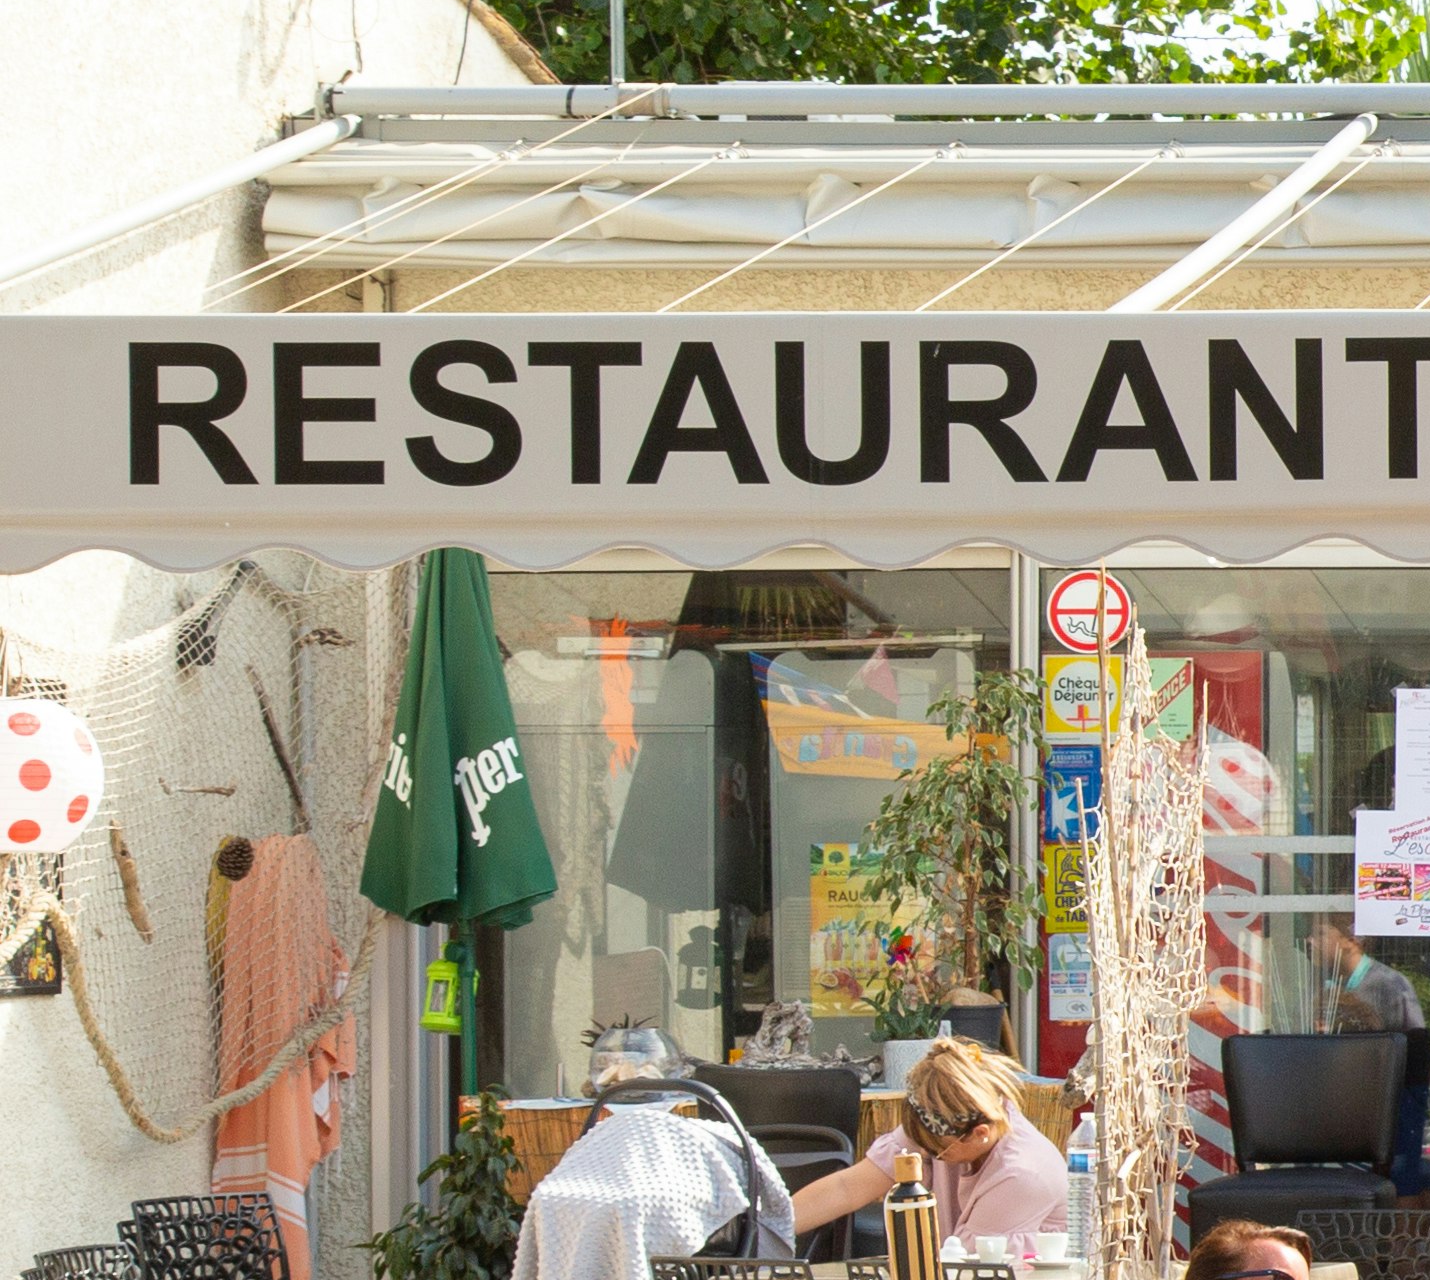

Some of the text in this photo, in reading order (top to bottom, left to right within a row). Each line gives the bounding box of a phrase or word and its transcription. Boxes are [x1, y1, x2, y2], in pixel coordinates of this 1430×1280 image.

[1058, 677, 1101, 692] Chèqu
[1054, 690, 1114, 704] Déjeunr
[828, 889, 868, 903] RAU
